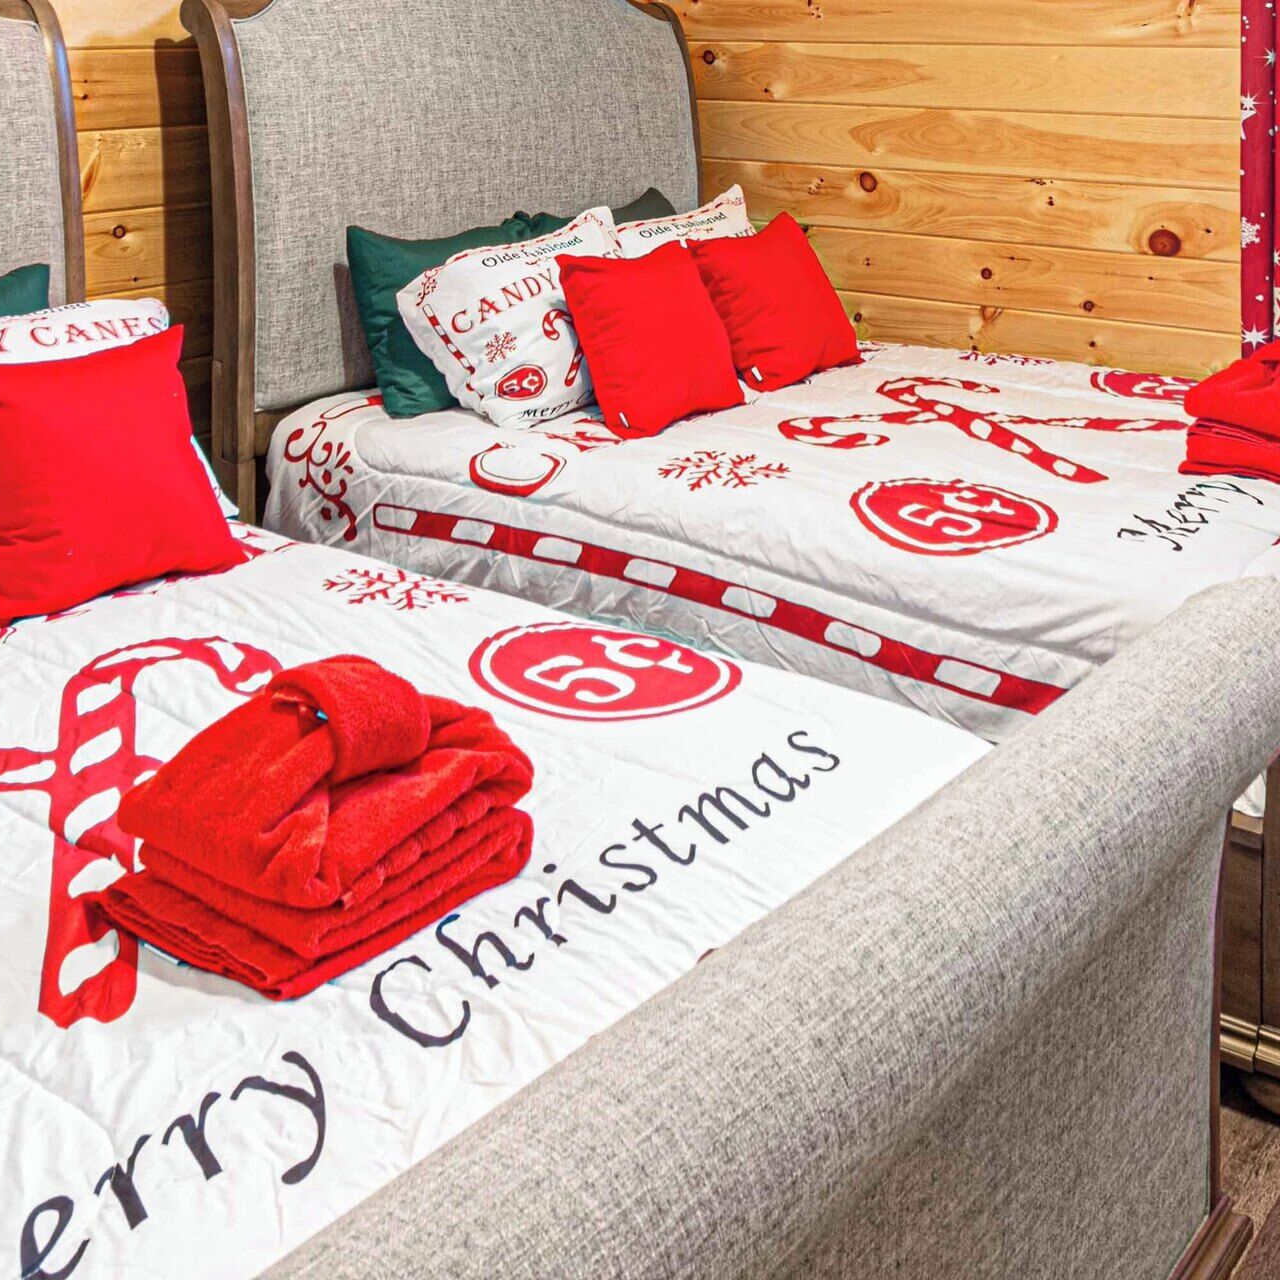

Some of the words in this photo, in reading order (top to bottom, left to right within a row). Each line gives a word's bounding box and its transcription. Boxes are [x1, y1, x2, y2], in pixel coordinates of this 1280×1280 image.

[482, 253, 521, 268] Olde
[521, 235, 583, 258] Fashioned
[639, 225, 672, 238] Olde
[672, 212, 728, 230] Fashioned
[450, 268, 558, 334] CANDY
[1116, 481, 1265, 551] Merry
[369, 730, 841, 1048] Christmas
